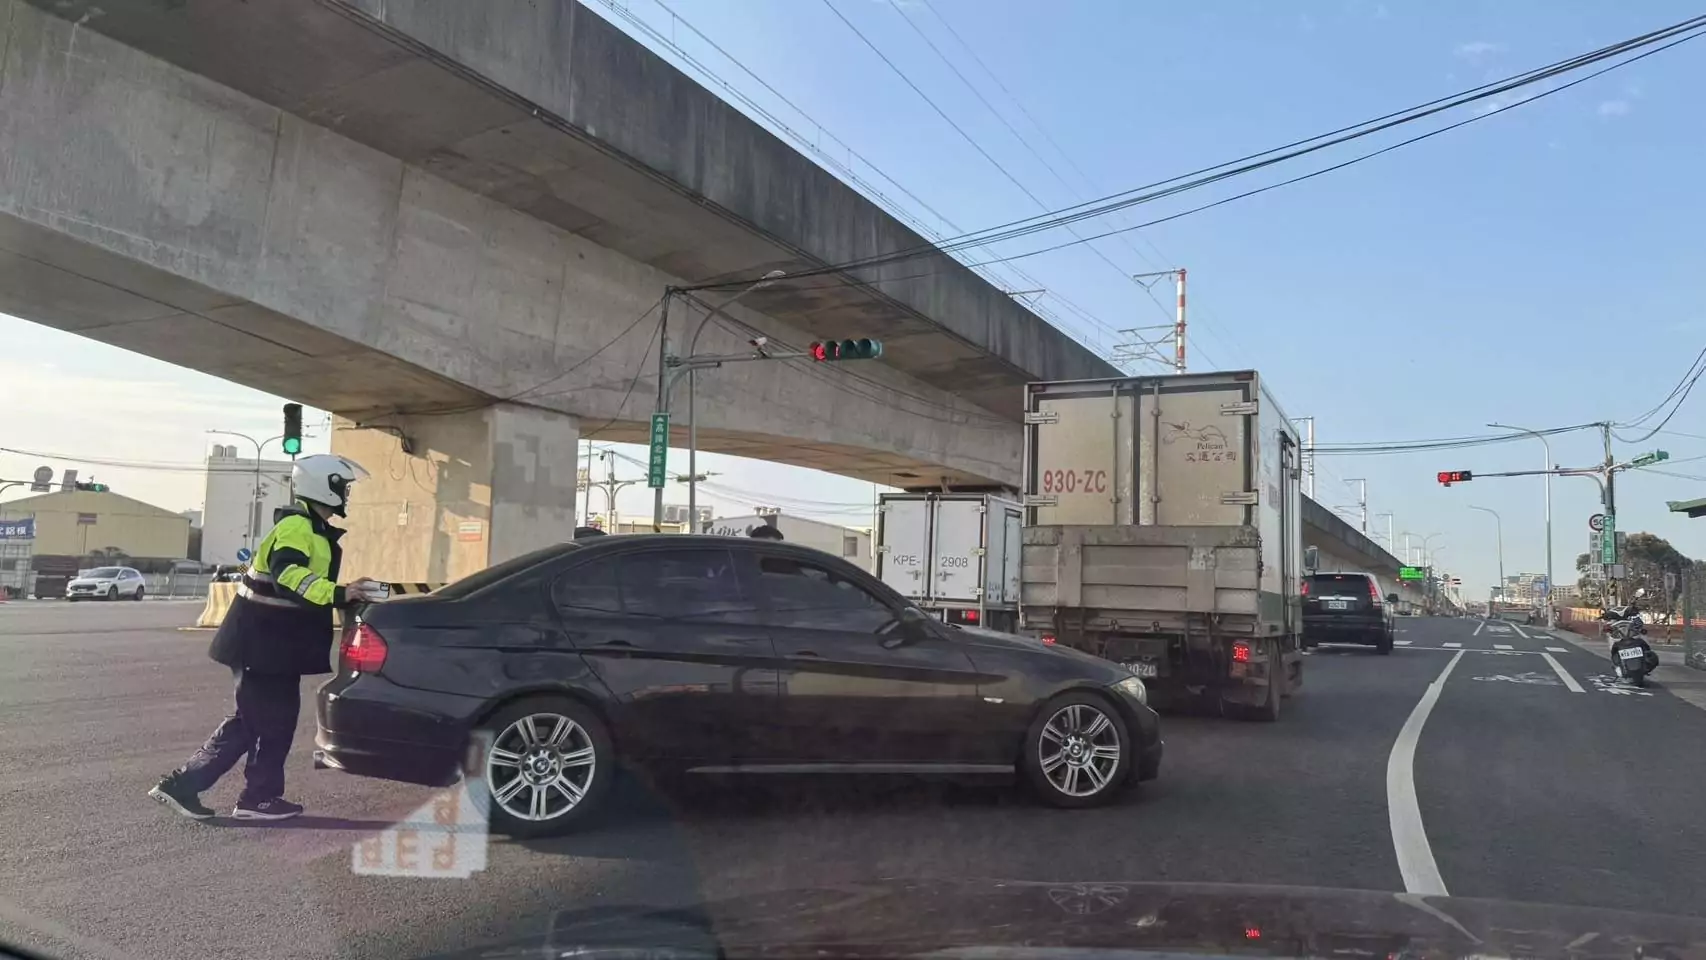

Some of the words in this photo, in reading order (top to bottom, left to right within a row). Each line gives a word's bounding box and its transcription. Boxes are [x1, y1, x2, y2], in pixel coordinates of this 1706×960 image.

[1197, 442, 1223, 450] Pelican
[1044, 470, 1106, 493] 930-ZC
[941, 556, 968, 567] 2908
